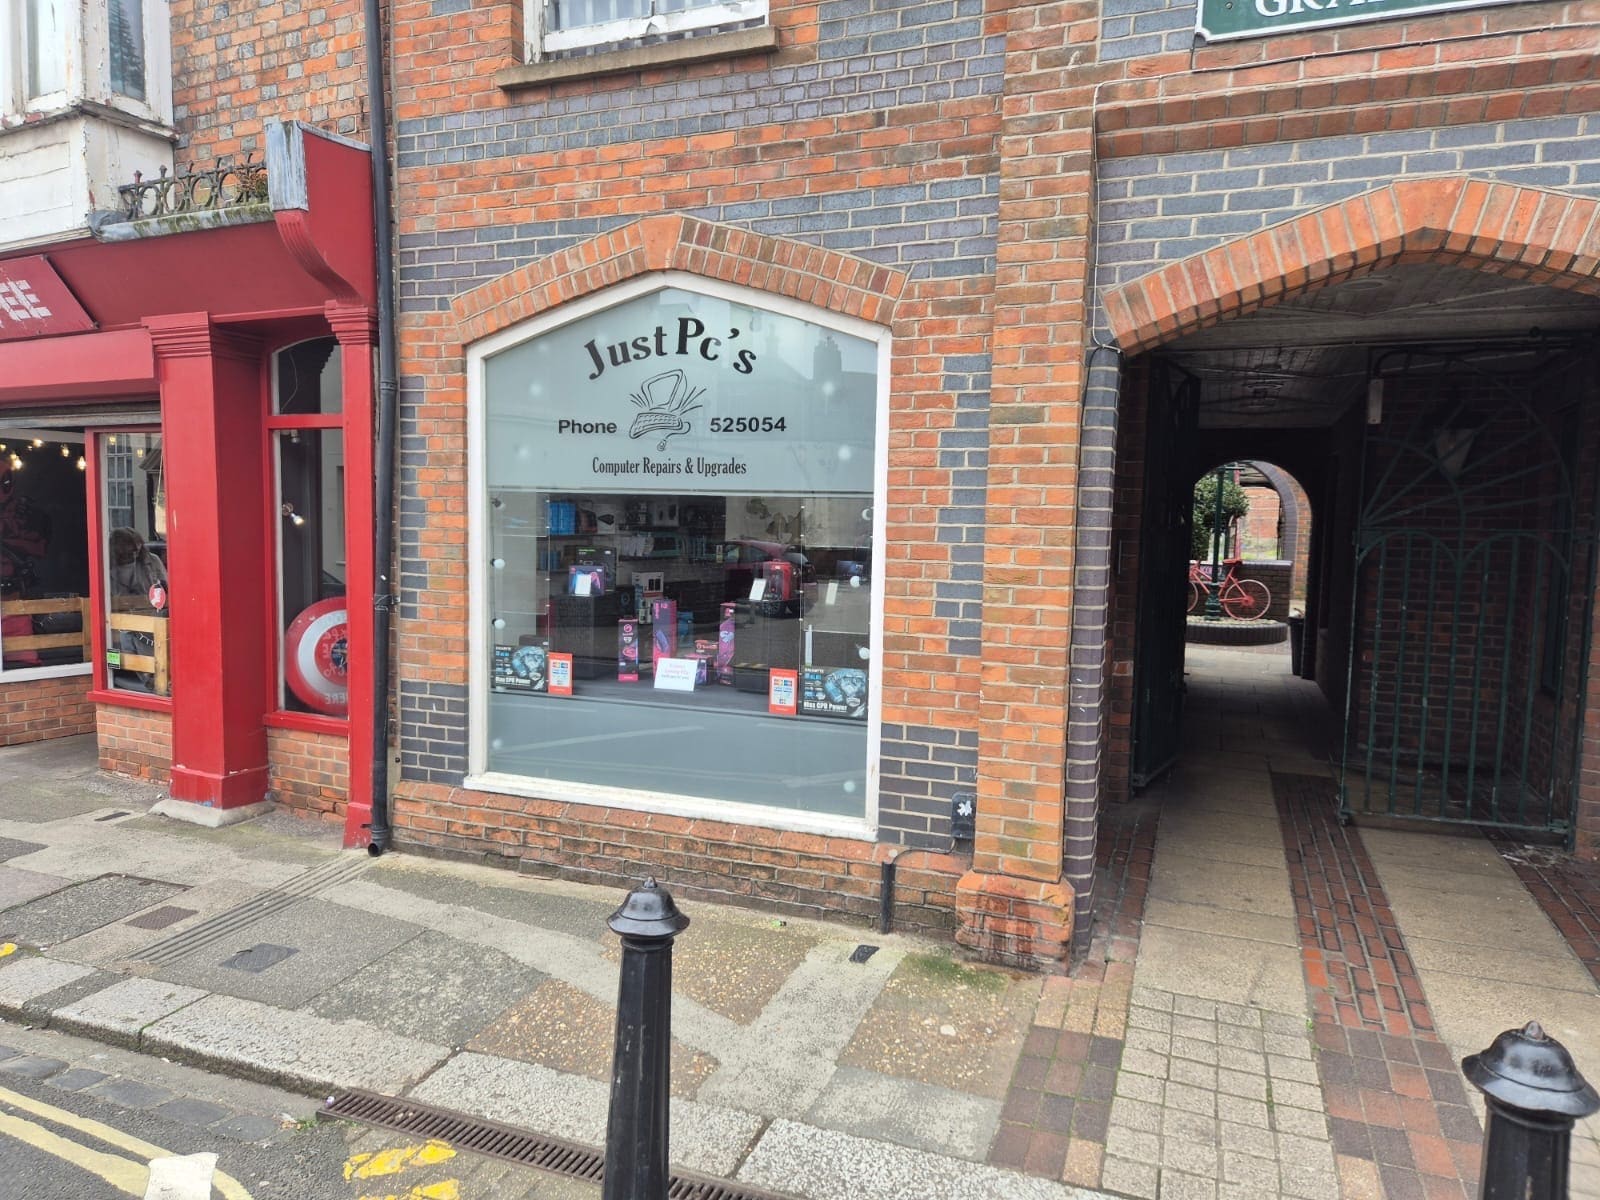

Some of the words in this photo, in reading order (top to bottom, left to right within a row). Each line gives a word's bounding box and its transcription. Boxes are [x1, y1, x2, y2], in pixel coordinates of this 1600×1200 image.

[584, 326, 668, 381] Just
[558, 419, 618, 434] Phone
[709, 417, 787, 433] 525054
[592, 457, 640, 476] Computer
[643, 457, 682, 476] Repairs
[684, 458, 694, 474] &
[697, 457, 747, 477] Upgrades
